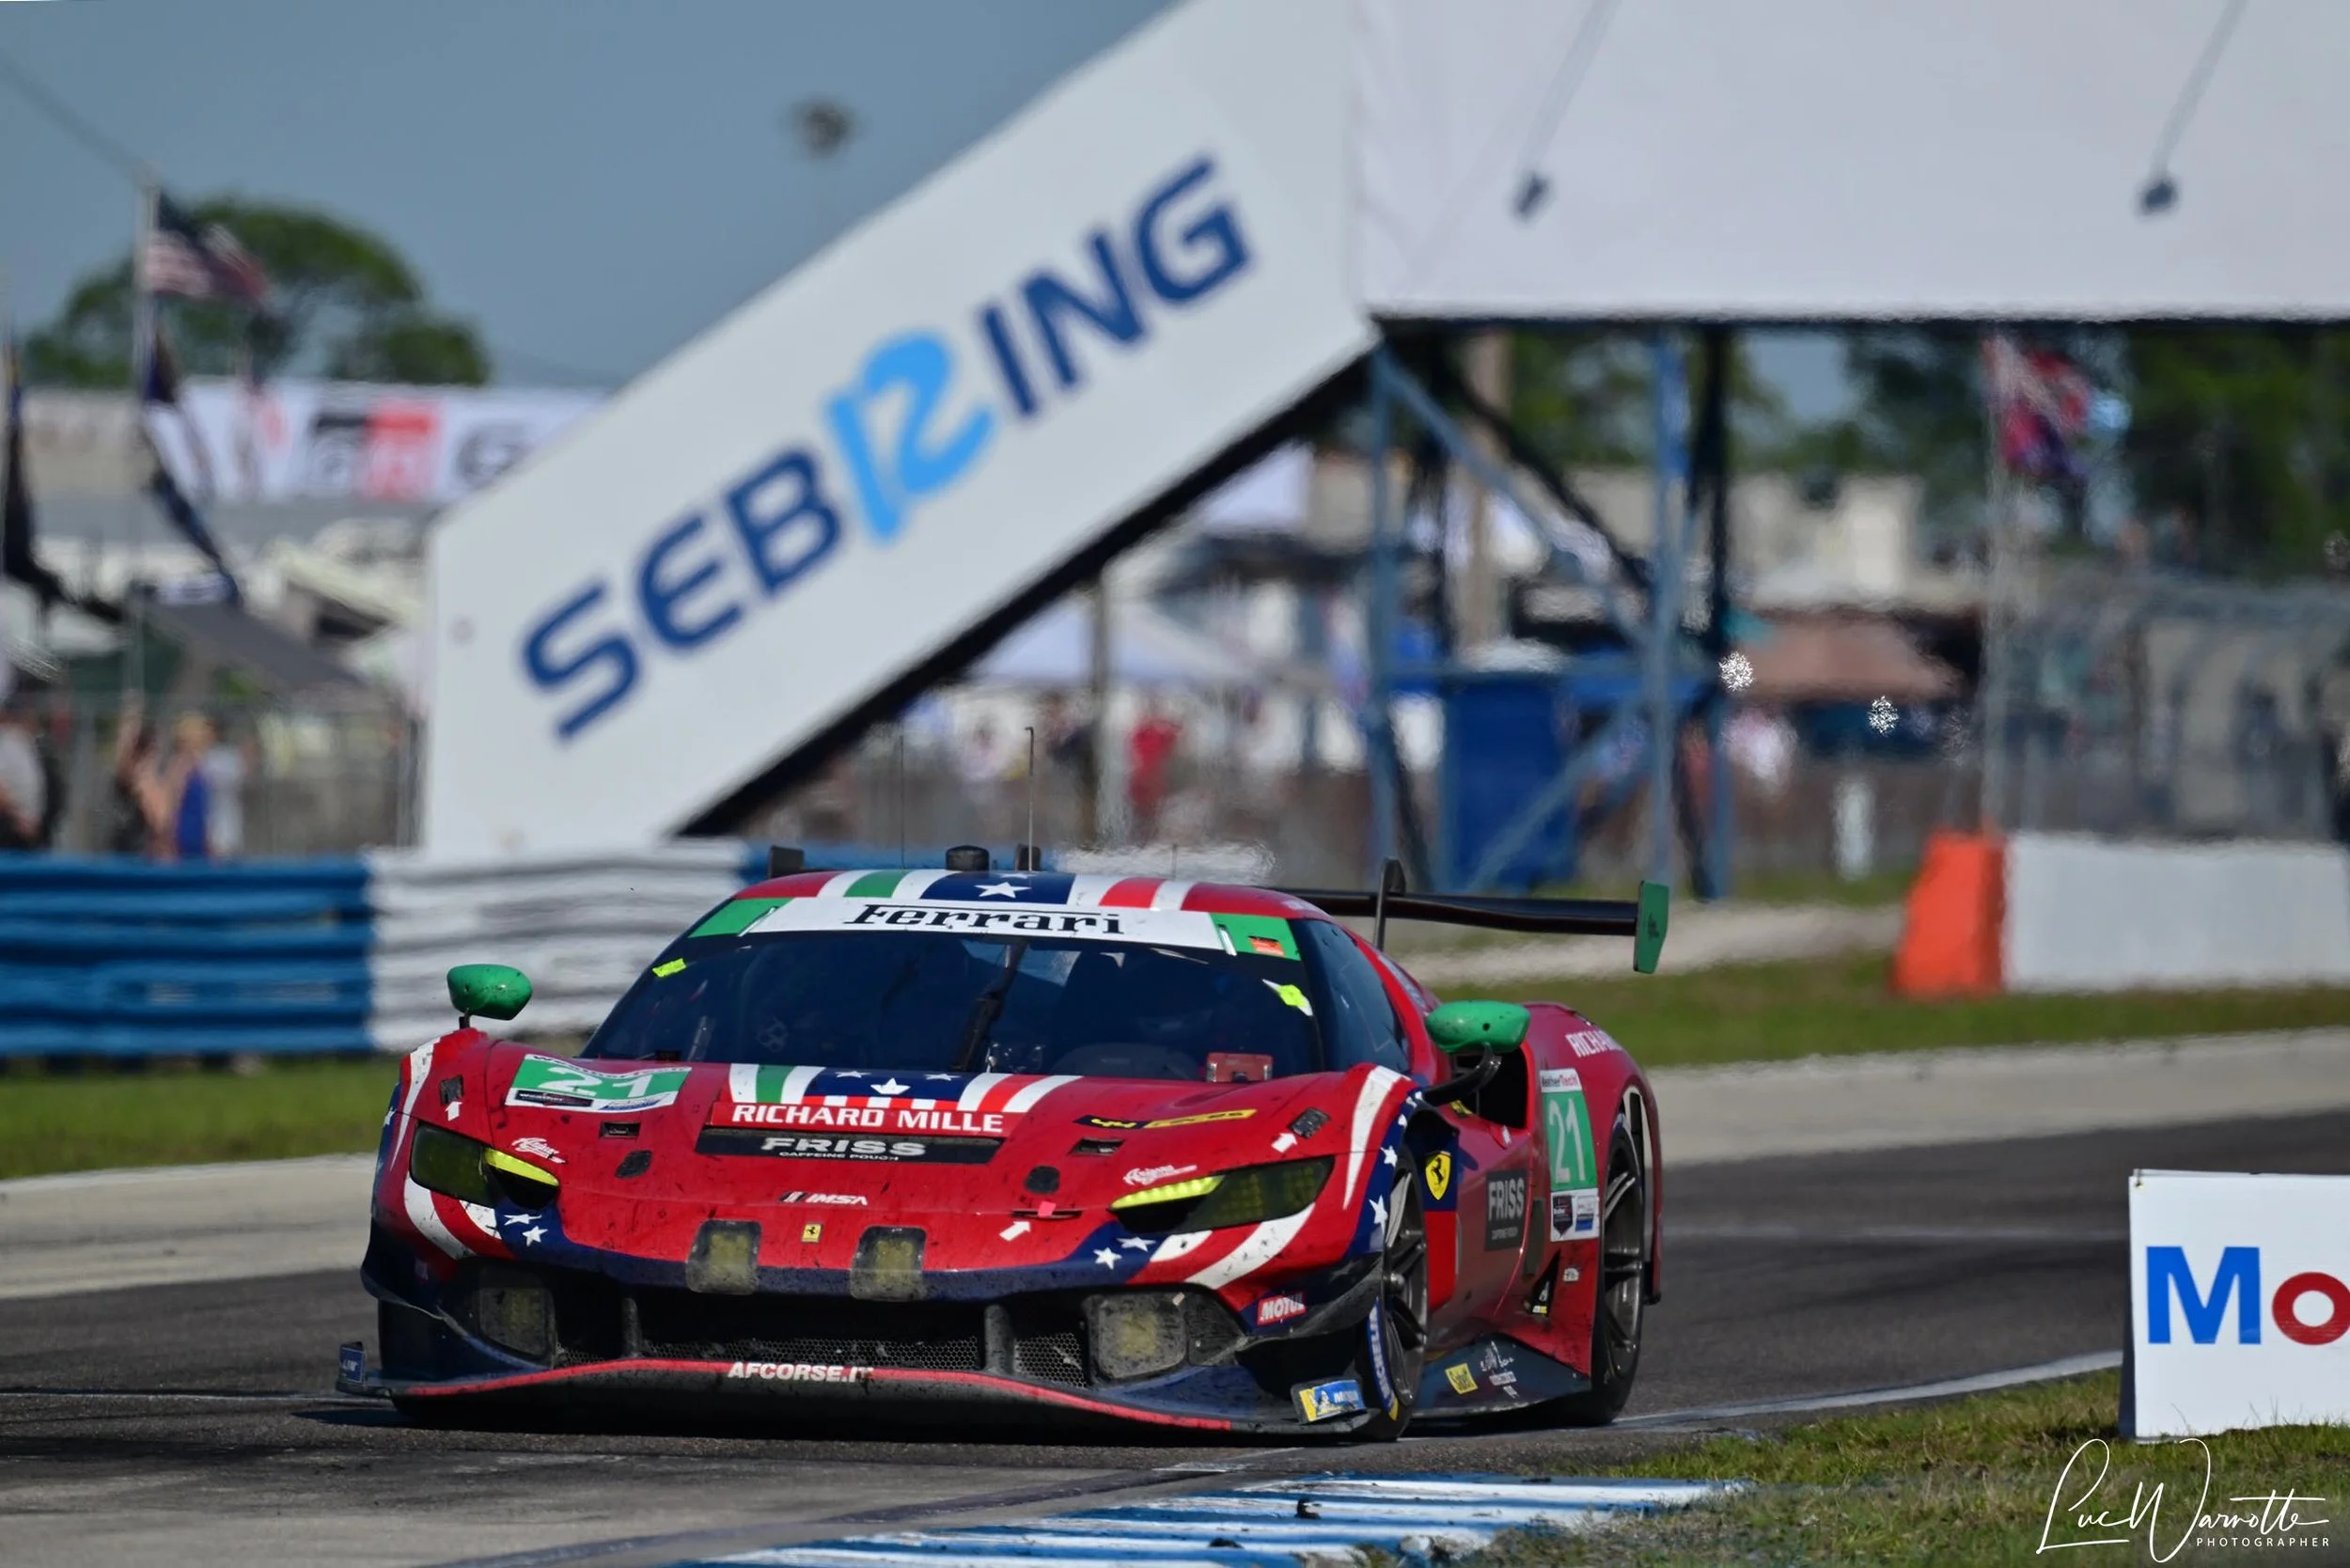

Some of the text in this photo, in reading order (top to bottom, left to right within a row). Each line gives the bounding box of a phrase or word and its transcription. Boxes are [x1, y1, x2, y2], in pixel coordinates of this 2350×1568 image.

[843, 903, 1125, 934] Ferrari
[537, 1066, 653, 1098] 21
[732, 1105, 1003, 1133] RICHARD MILLE
[760, 1137, 926, 1156] FRISS
[1548, 1098, 1586, 1183] 21
[778, 1151, 899, 1161] CAFFEINE POUCH
[806, 1192, 869, 1205] IMSA
[1488, 1177, 1525, 1221] FRISS
[1261, 1293, 1305, 1321] MOTUL
[2145, 1246, 2350, 1345] Mo
[728, 1362, 873, 1383] AFCORSE.IT
